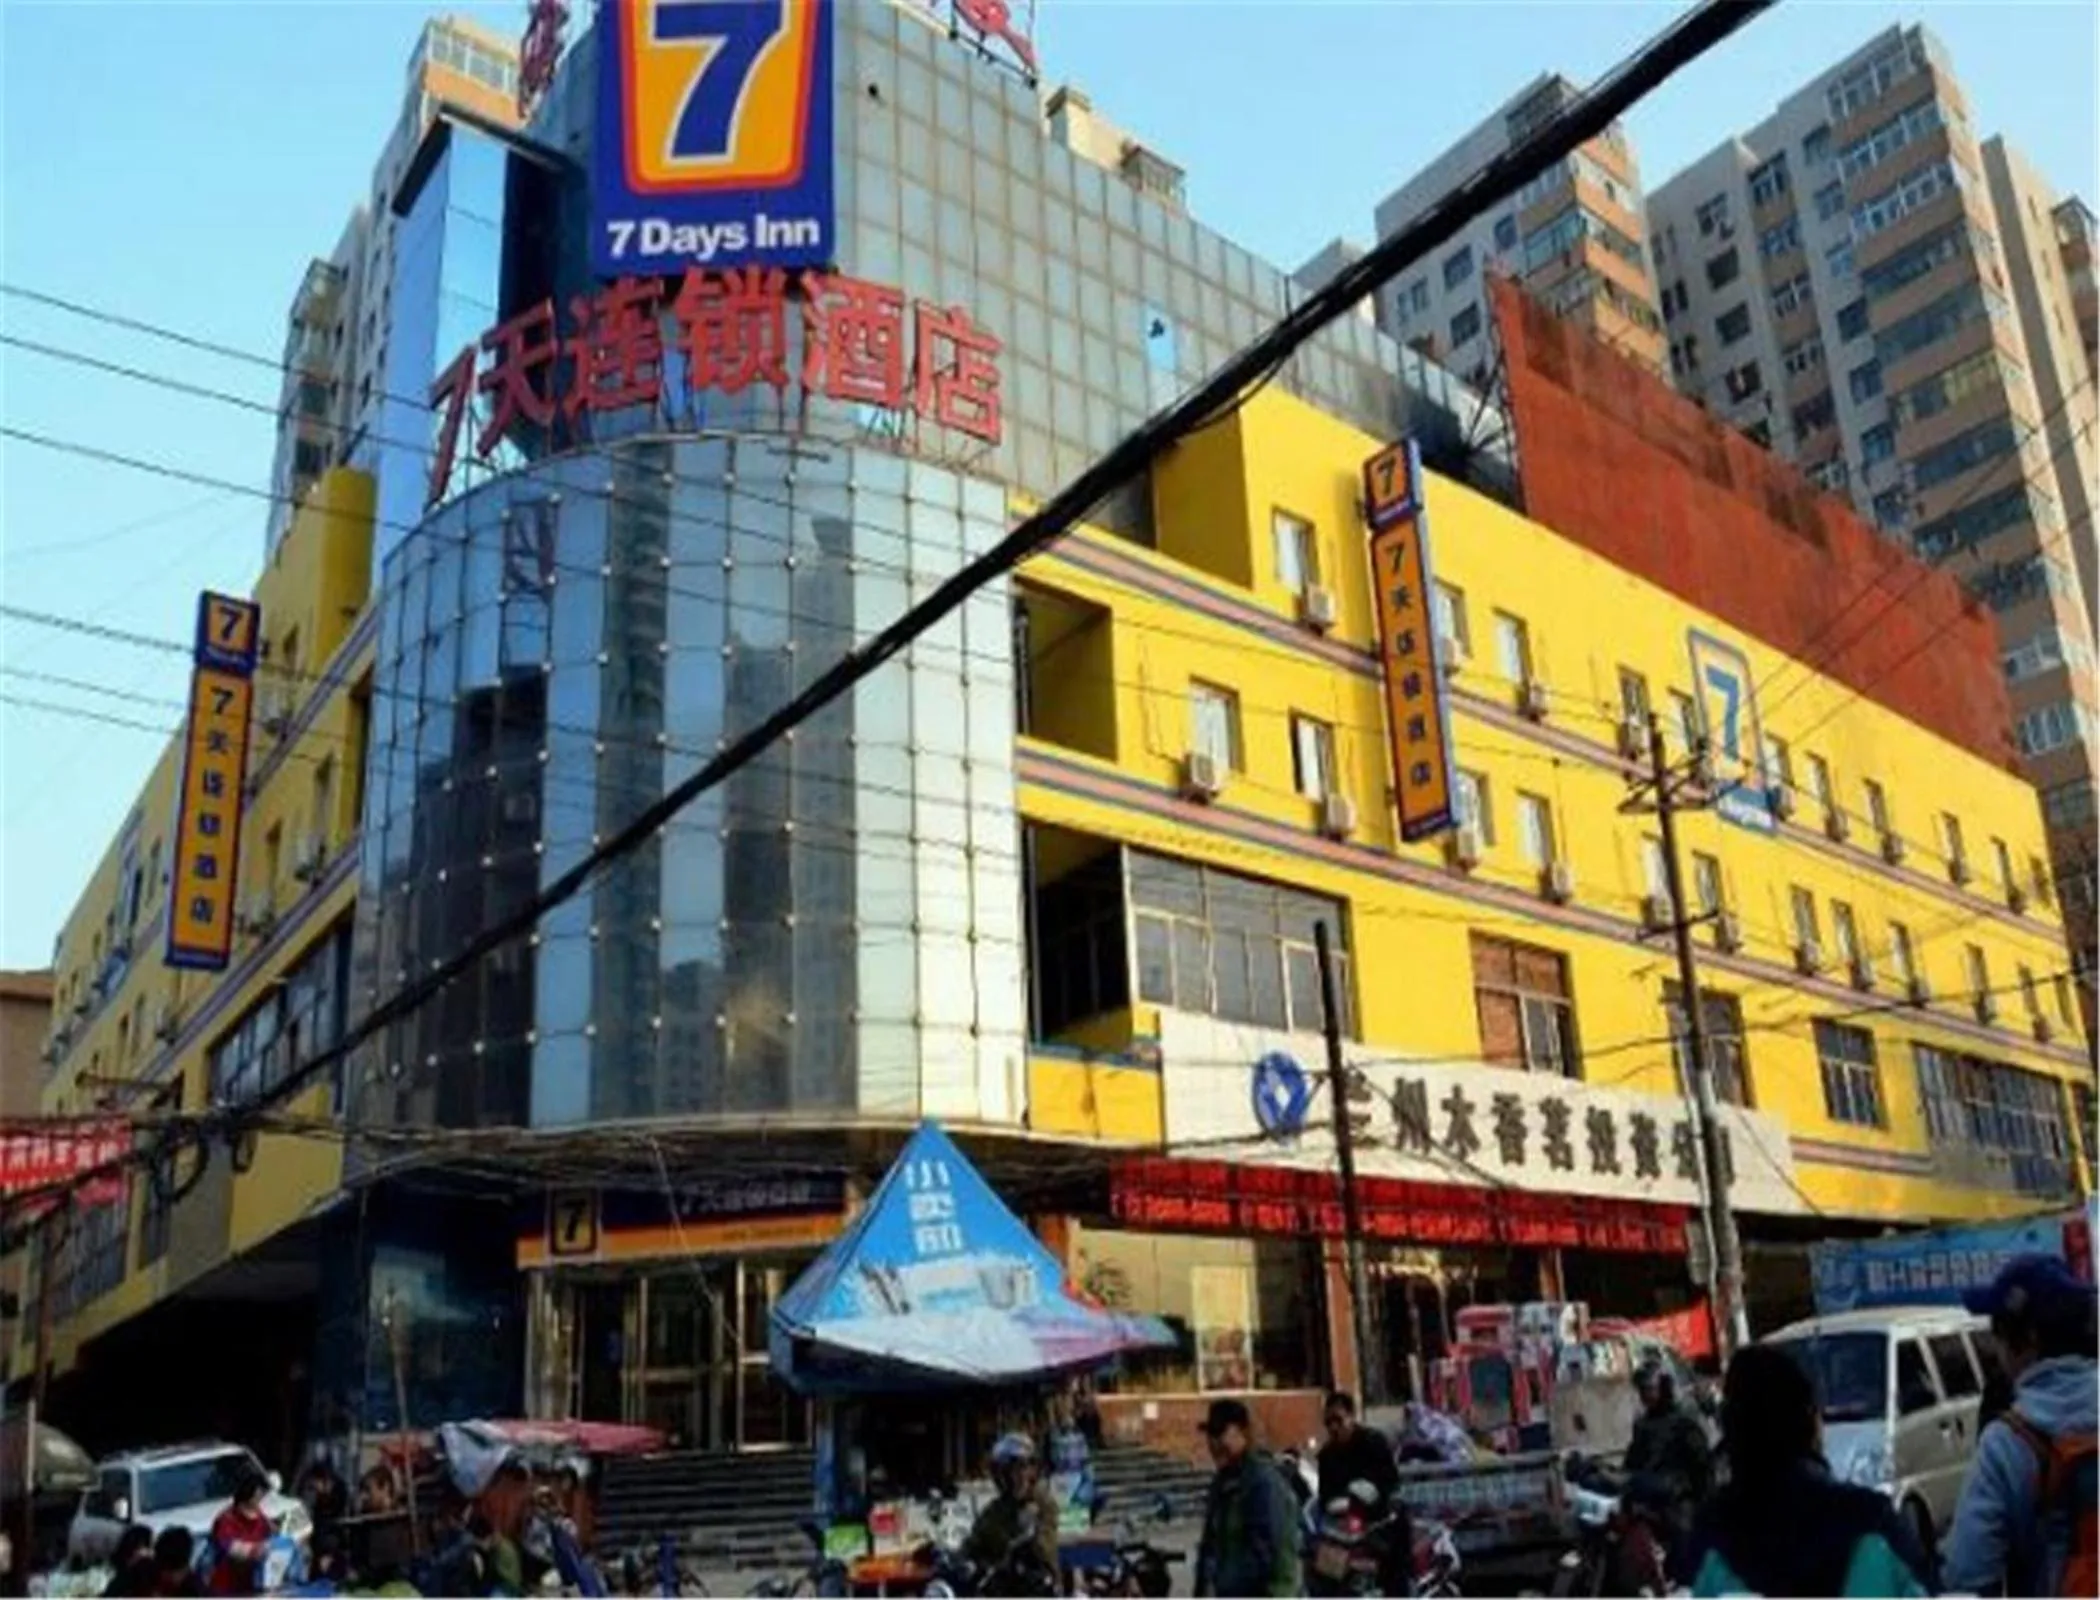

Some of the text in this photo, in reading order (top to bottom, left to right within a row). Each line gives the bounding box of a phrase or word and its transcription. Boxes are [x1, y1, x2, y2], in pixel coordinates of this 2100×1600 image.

[652, 1, 793, 164] 7
[607, 213, 820, 262] 7 Days Inn
[428, 263, 1002, 507] 7天连锁酒店
[1378, 456, 1397, 496] 7
[218, 606, 242, 641] 7
[1705, 664, 1739, 761] 7
